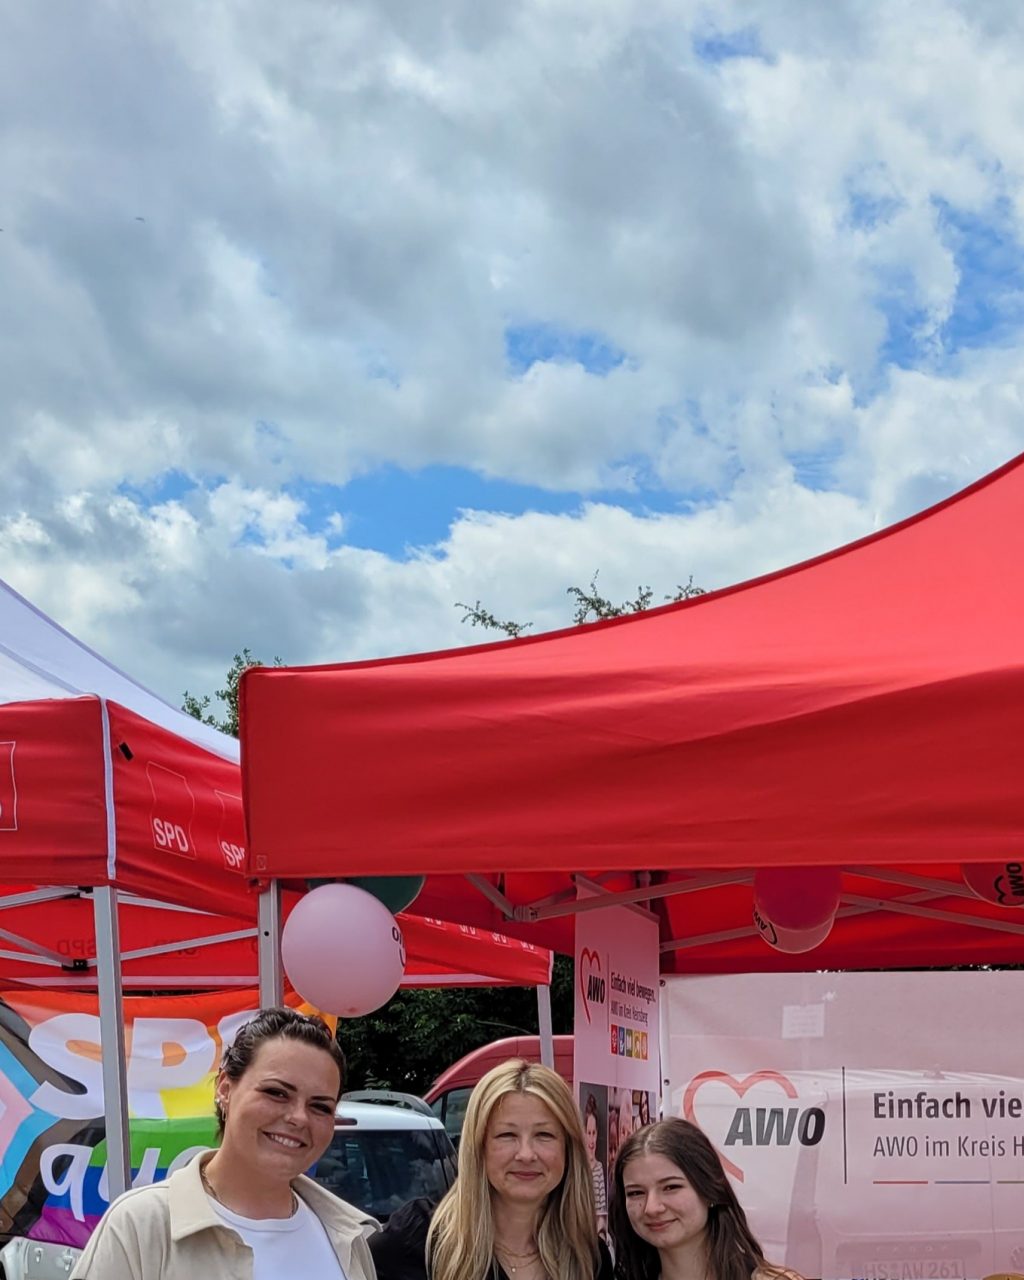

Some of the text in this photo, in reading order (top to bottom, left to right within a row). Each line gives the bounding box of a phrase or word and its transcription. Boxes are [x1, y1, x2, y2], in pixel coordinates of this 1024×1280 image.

[153, 818, 189, 852] SPD
[587, 974, 605, 1004] AWO
[28, 1009, 258, 1120] SP
[873, 1091, 971, 1119] Einfach
[724, 1107, 825, 1146] AWO
[873, 1136, 918, 1157] AWO
[925, 1136, 949, 1157] im
[958, 1135, 1005, 1157] Kreis
[928, 1261, 960, 1280] 261
